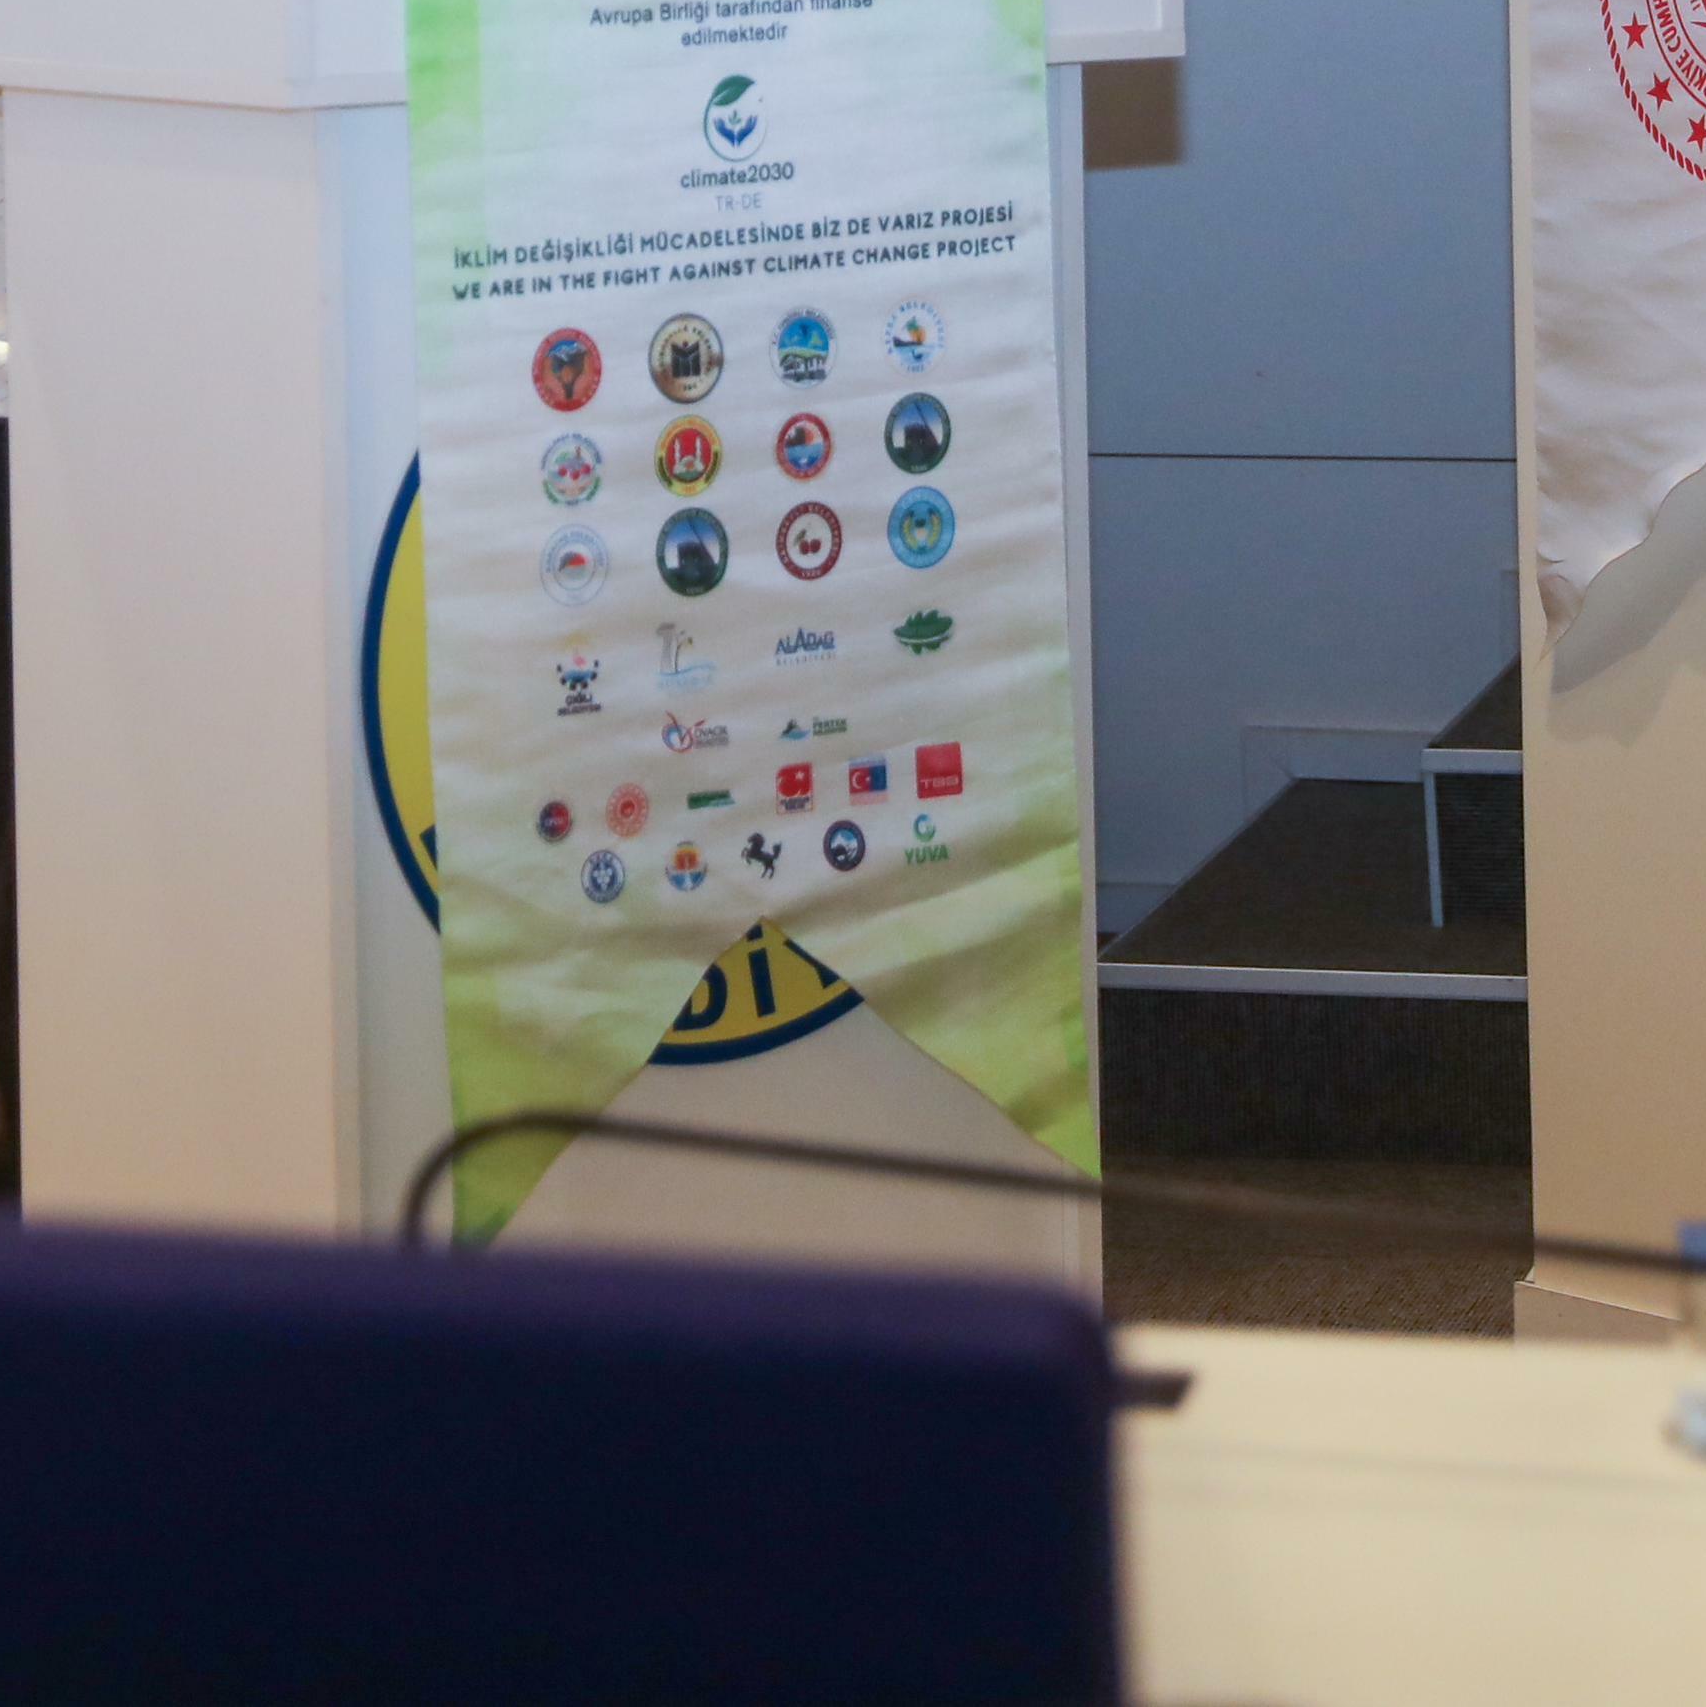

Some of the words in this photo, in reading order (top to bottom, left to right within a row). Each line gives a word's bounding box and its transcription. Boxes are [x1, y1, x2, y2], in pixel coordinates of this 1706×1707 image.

[591, 8, 653, 26] Avrupa
[661, 2, 710, 23] Birliği
[682, 23, 787, 46] edilmektedir
[681, 162, 794, 188] climate2030
[716, 192, 761, 211] TR-DE
[455, 246, 507, 268] İKLİM
[516, 234, 634, 264] DEĞİŞİKLİĞİ
[642, 221, 805, 251] MÜCADELESİNDE
[812, 217, 840, 239] BİZ
[848, 218, 870, 235] DE
[878, 212, 933, 231] VARIZ
[941, 200, 1013, 227] PROJESİ
[453, 282, 480, 300] WE
[489, 278, 524, 296] ARE
[532, 277, 551, 292] IN
[560, 272, 595, 290] THE
[603, 267, 660, 286] FIGHT
[670, 258, 755, 280] AGAINST
[763, 251, 845, 273] CLIMATE
[852, 243, 930, 265] CHANGE
[937, 235, 1015, 257] PROJECT
[905, 845, 949, 865] YUVA
